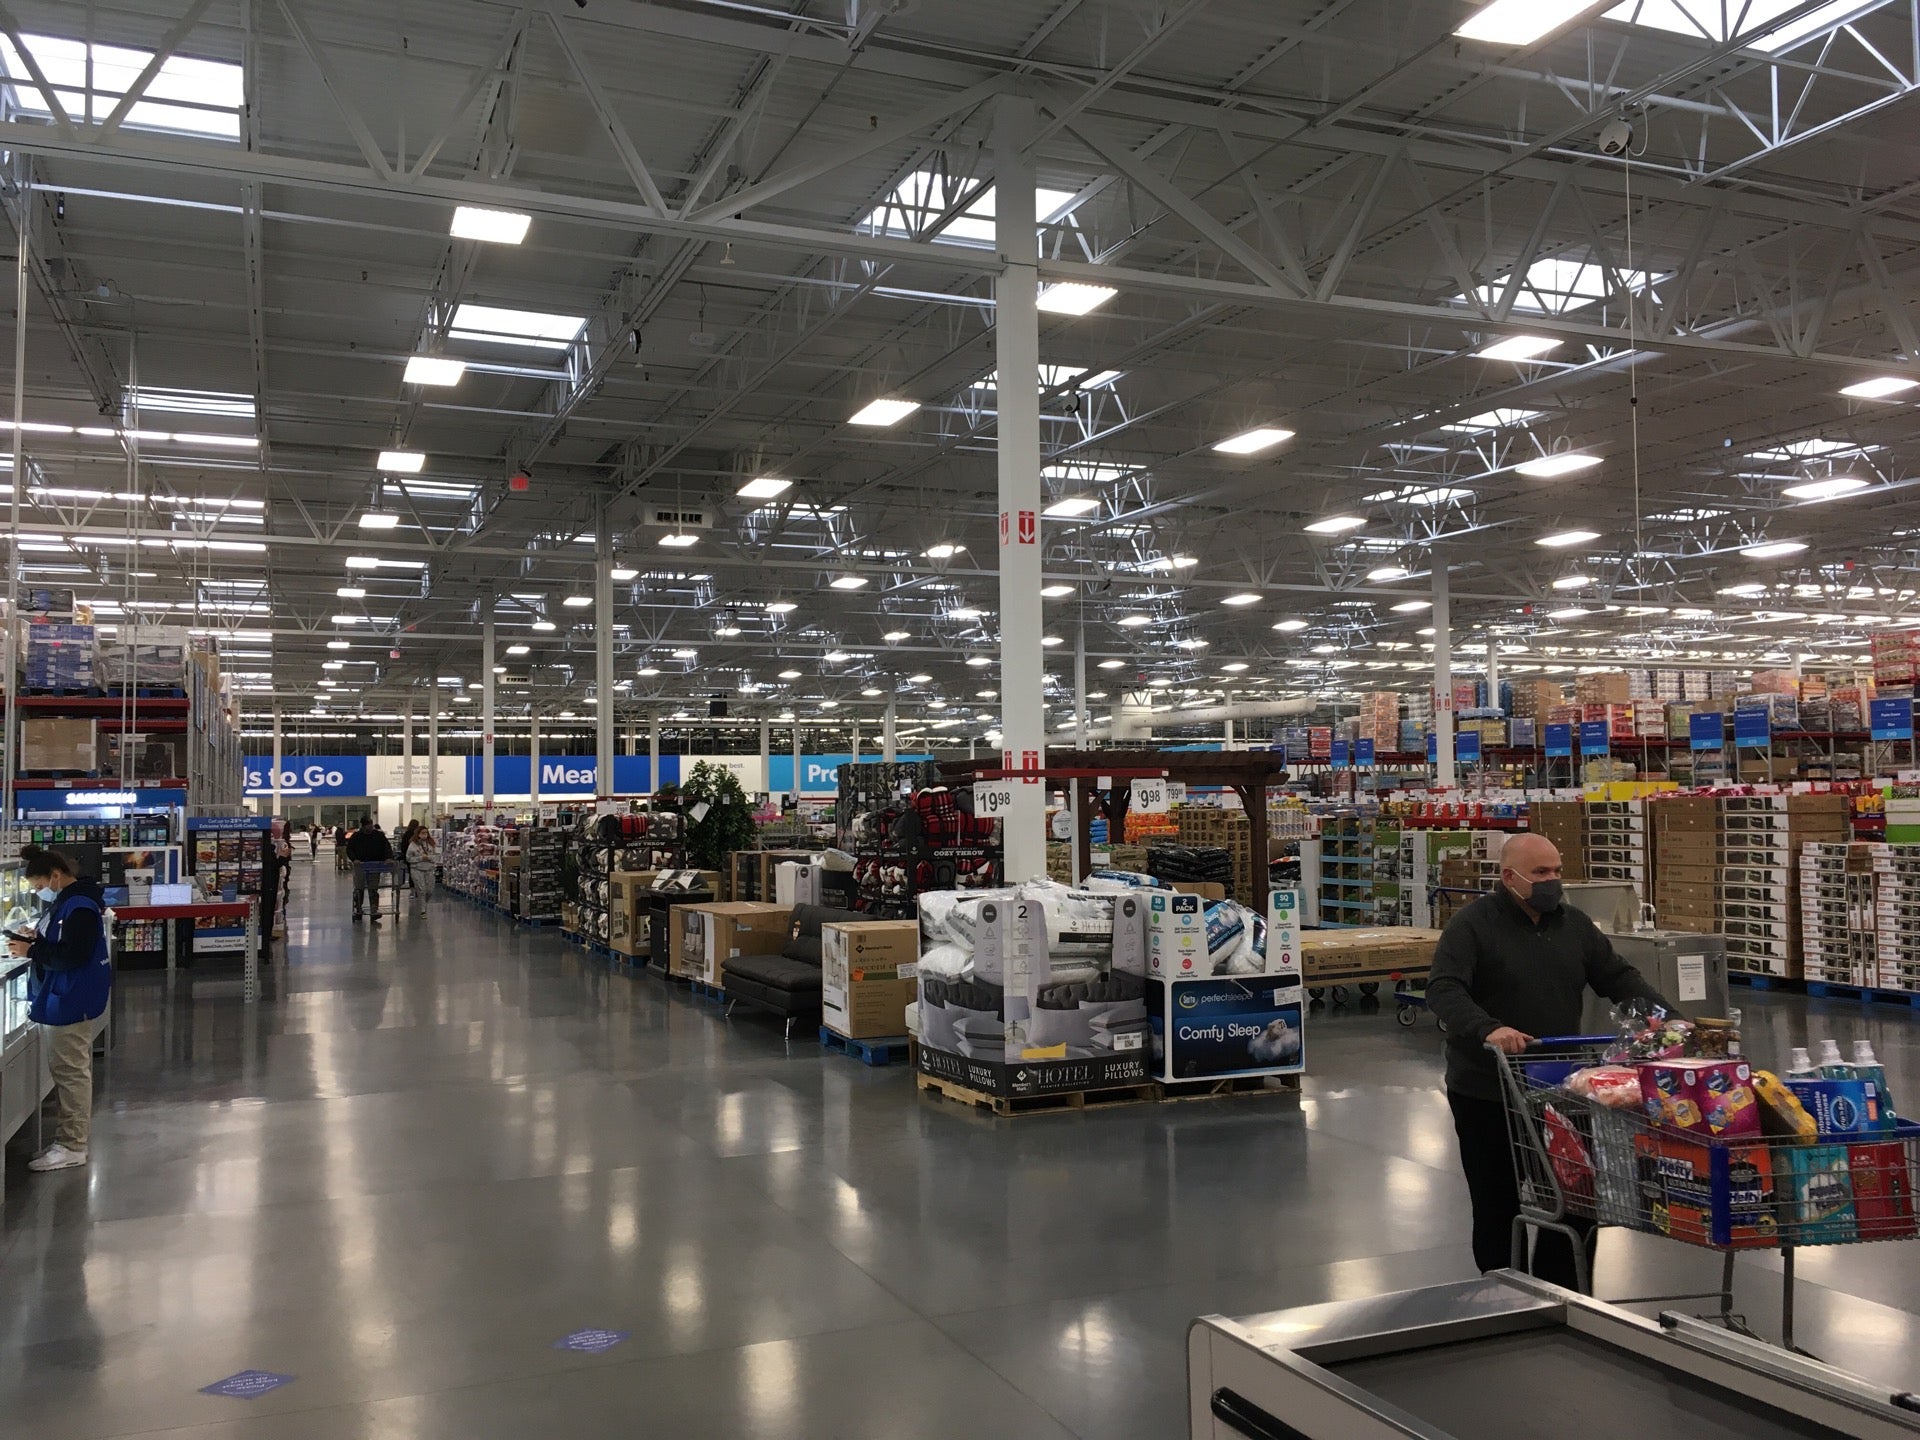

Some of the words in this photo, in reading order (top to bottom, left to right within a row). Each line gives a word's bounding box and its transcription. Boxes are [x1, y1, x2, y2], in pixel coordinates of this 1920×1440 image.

[303, 765, 344, 787] Go
[1279, 894, 1289, 902] SQ
[1017, 905, 1028, 919] 2
[1179, 1024, 1224, 1042] Comfy
[1228, 1023, 1261, 1039] Sleep
[931, 1053, 965, 1076] HOTEL
[968, 1064, 992, 1078] LUXURY
[1104, 1061, 1140, 1072] LUXURY
[969, 1073, 997, 1088] PILLOWS
[1037, 1065, 1094, 1084] HOTEL
[1104, 1068, 1144, 1080] PILLOWS
[1822, 1093, 1831, 1135] Freshness
[1659, 1160, 1692, 1180] Hefty
[1729, 1191, 1758, 1203] Hefty
